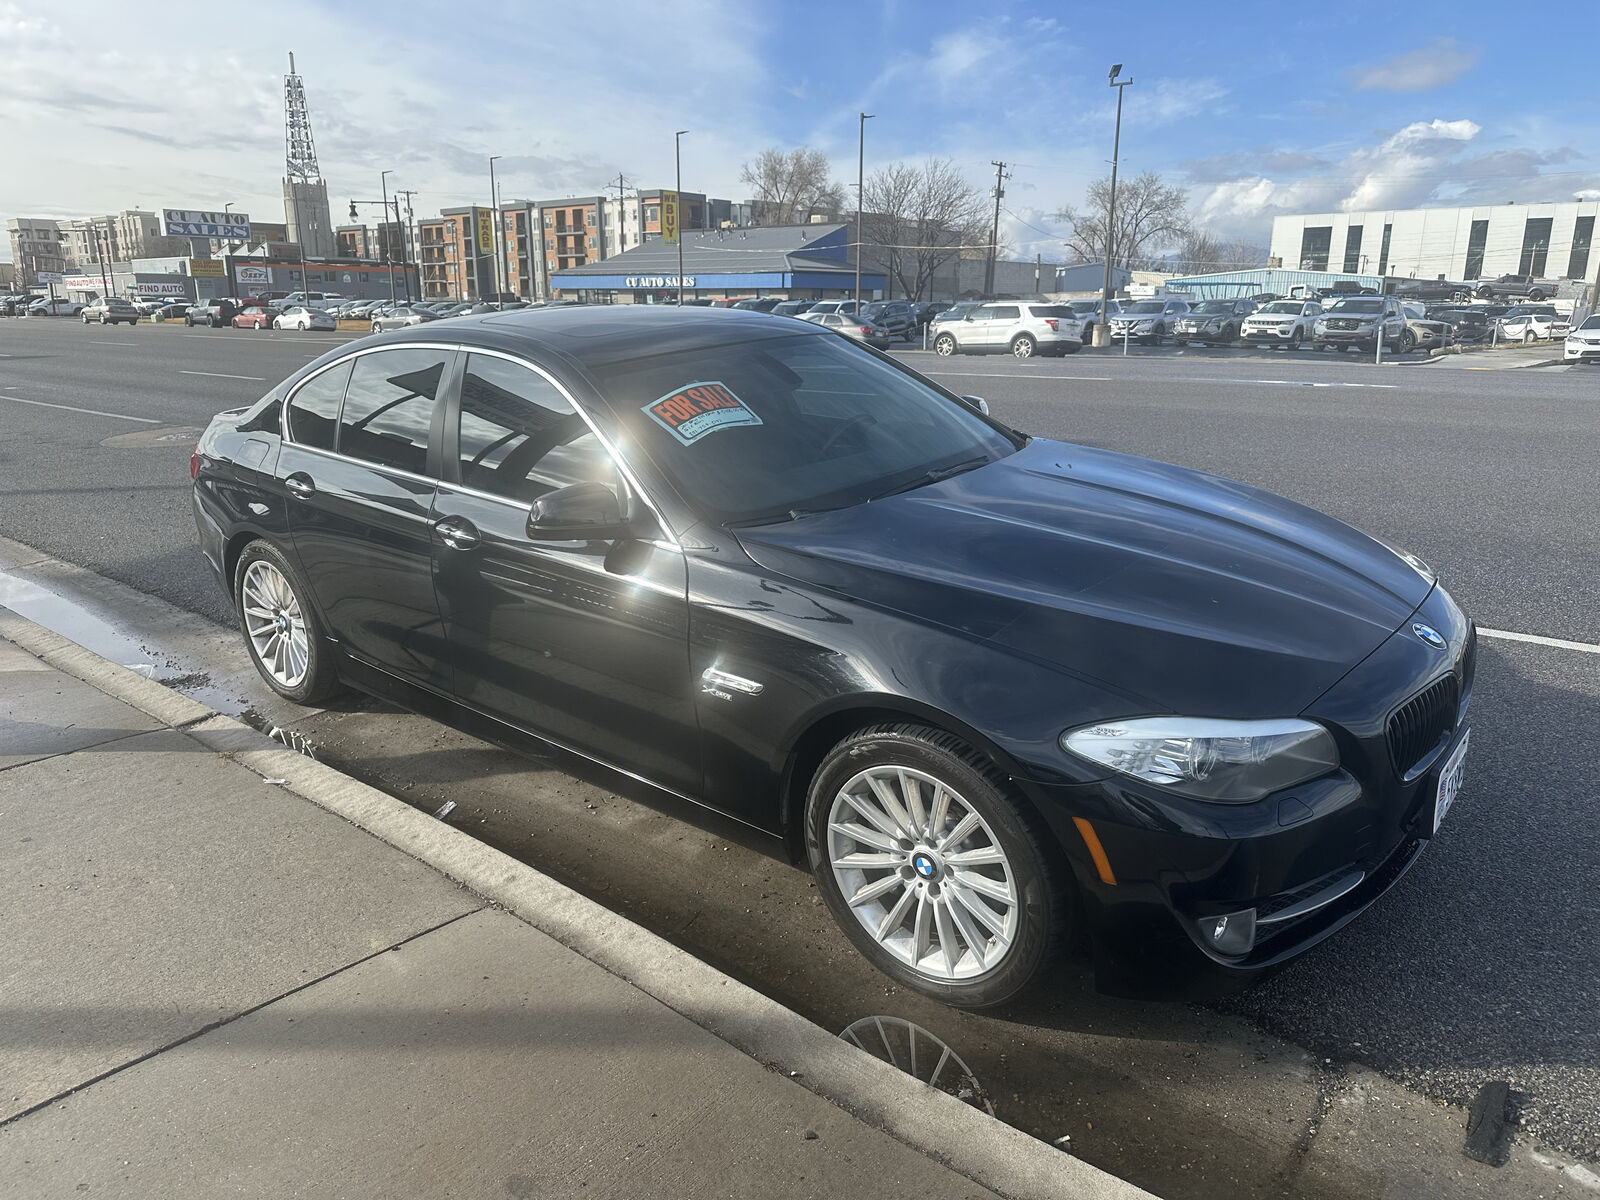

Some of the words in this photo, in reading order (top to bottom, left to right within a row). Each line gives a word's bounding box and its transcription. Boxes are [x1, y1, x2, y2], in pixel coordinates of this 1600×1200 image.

[663, 194, 676, 203] WE
[166, 211, 188, 222] CU
[198, 213, 246, 226] AUTO
[666, 204, 675, 238] BUY
[169, 222, 248, 237] SALES
[139, 284, 159, 293] FIND
[161, 284, 184, 293] AUTO
[625, 277, 639, 287] CU
[640, 277, 664, 287] AUTO
[654, 395, 702, 426] FOR
[688, 385, 741, 410] SALE
